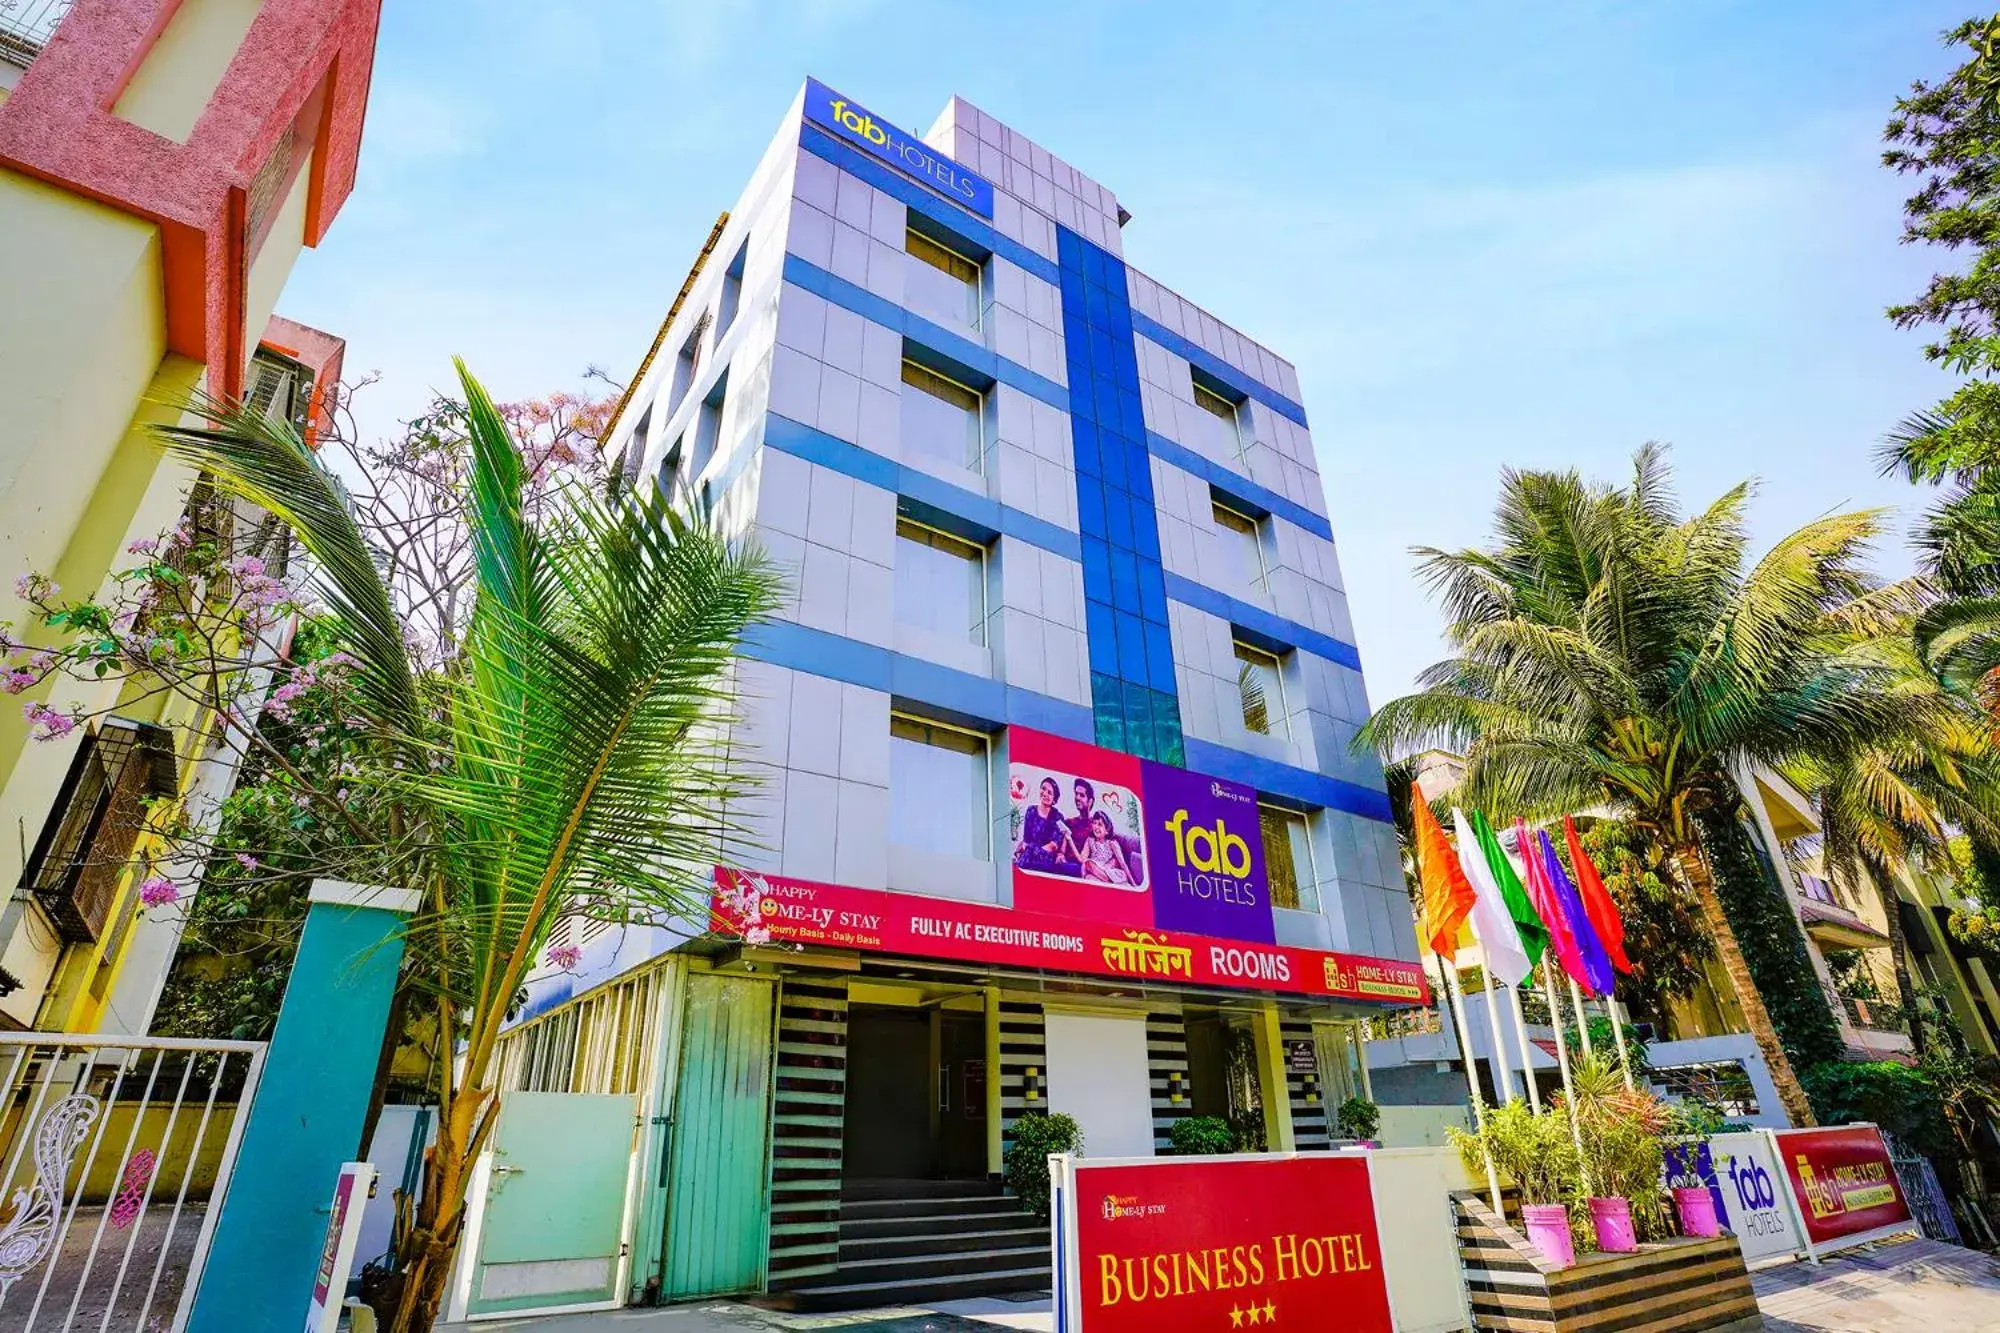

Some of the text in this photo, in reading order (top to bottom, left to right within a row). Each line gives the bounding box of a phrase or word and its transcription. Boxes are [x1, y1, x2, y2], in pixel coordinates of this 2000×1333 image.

[830, 100, 975, 198] fab HOTELS
[1165, 809, 1251, 879] fab
[769, 884, 816, 900] HAPPY
[1178, 871, 1256, 906] HOTELS
[800, 928, 825, 939] Basis
[832, 931, 855, 944] Daily
[856, 934, 881, 946] Basis
[839, 911, 881, 930] STAY
[911, 916, 1084, 953] FULLY AC EXECUTIVE ROOMS
[1101, 928, 1193, 978] लॉजिंग
[1210, 946, 1290, 982] ROOMS
[1356, 965, 1418, 985] HOME-LY STAY
[1728, 1155, 1775, 1211] fab
[1147, 1204, 1166, 1215] STAY
[1745, 1210, 1785, 1238] HOTELS
[1098, 1232, 1371, 1307] BUSINESS HOTEL
